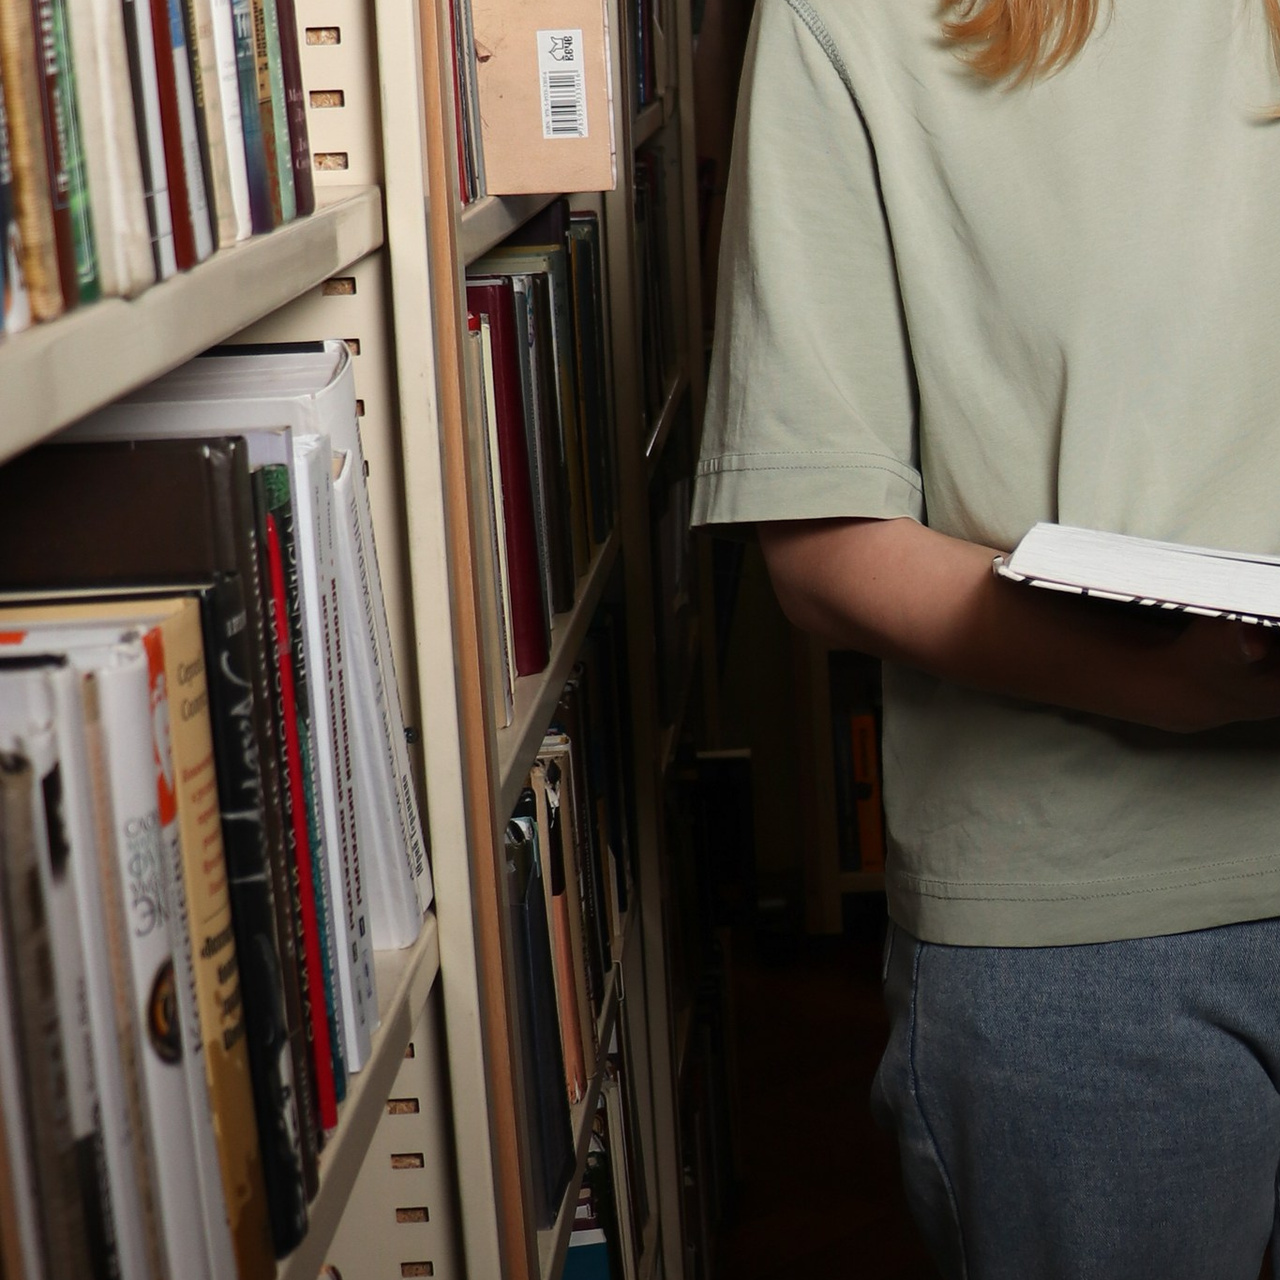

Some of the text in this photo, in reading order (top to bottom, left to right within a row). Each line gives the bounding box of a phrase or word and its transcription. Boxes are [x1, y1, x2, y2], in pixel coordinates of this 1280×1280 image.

[267, 596, 295, 814] ФИЛОСОФИЯ
[321, 594, 356, 932] ИСТОРИЯ ИСПАНСКОЙ ЛИТЕРАТУРЫ
[330, 578, 363, 906] ИСТОРИЯ ИСПАНСКОЙ ЛИТЕРАТУРЫ
[291, 862, 315, 1042] СУМЕРКИ
